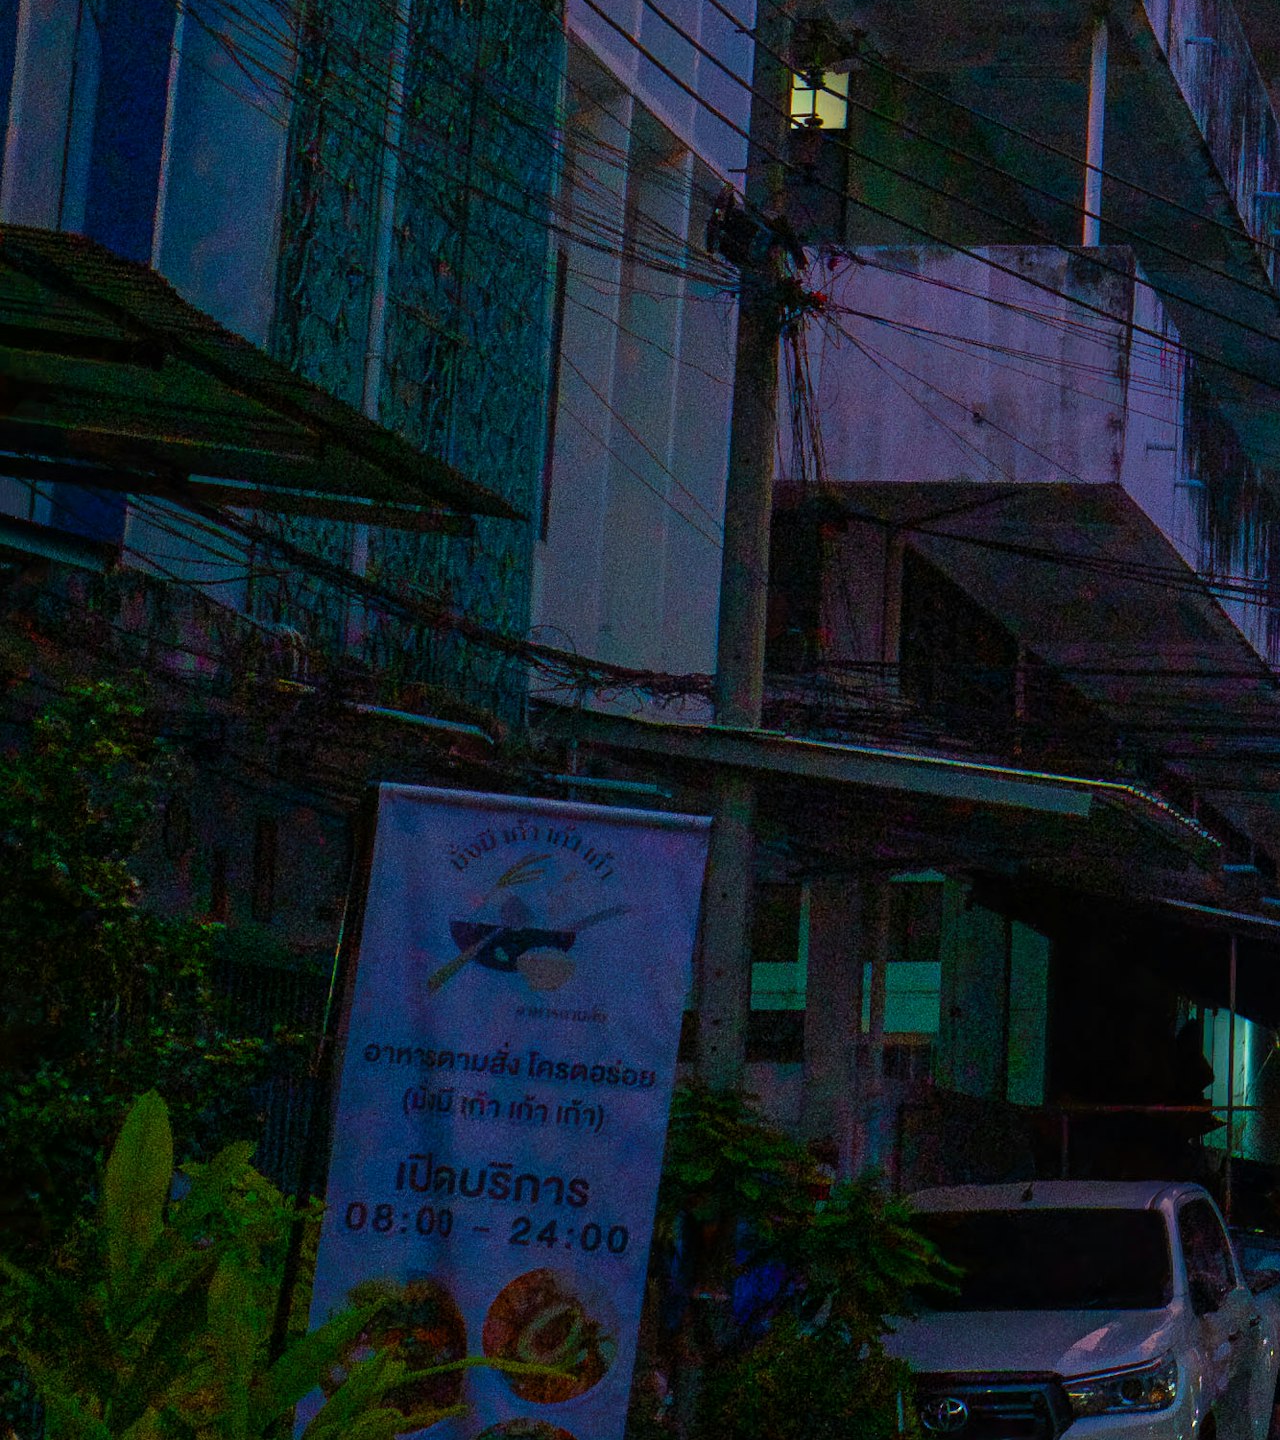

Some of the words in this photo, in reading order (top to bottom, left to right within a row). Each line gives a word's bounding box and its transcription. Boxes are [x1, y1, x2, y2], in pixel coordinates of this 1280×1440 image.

[363, 1041, 522, 1077] อาหารตามสั่ง
[394, 1152, 591, 1209] เปิดบริการ
[344, 1201, 454, 1238] 08:00
[509, 1216, 630, 1255] 24:00
